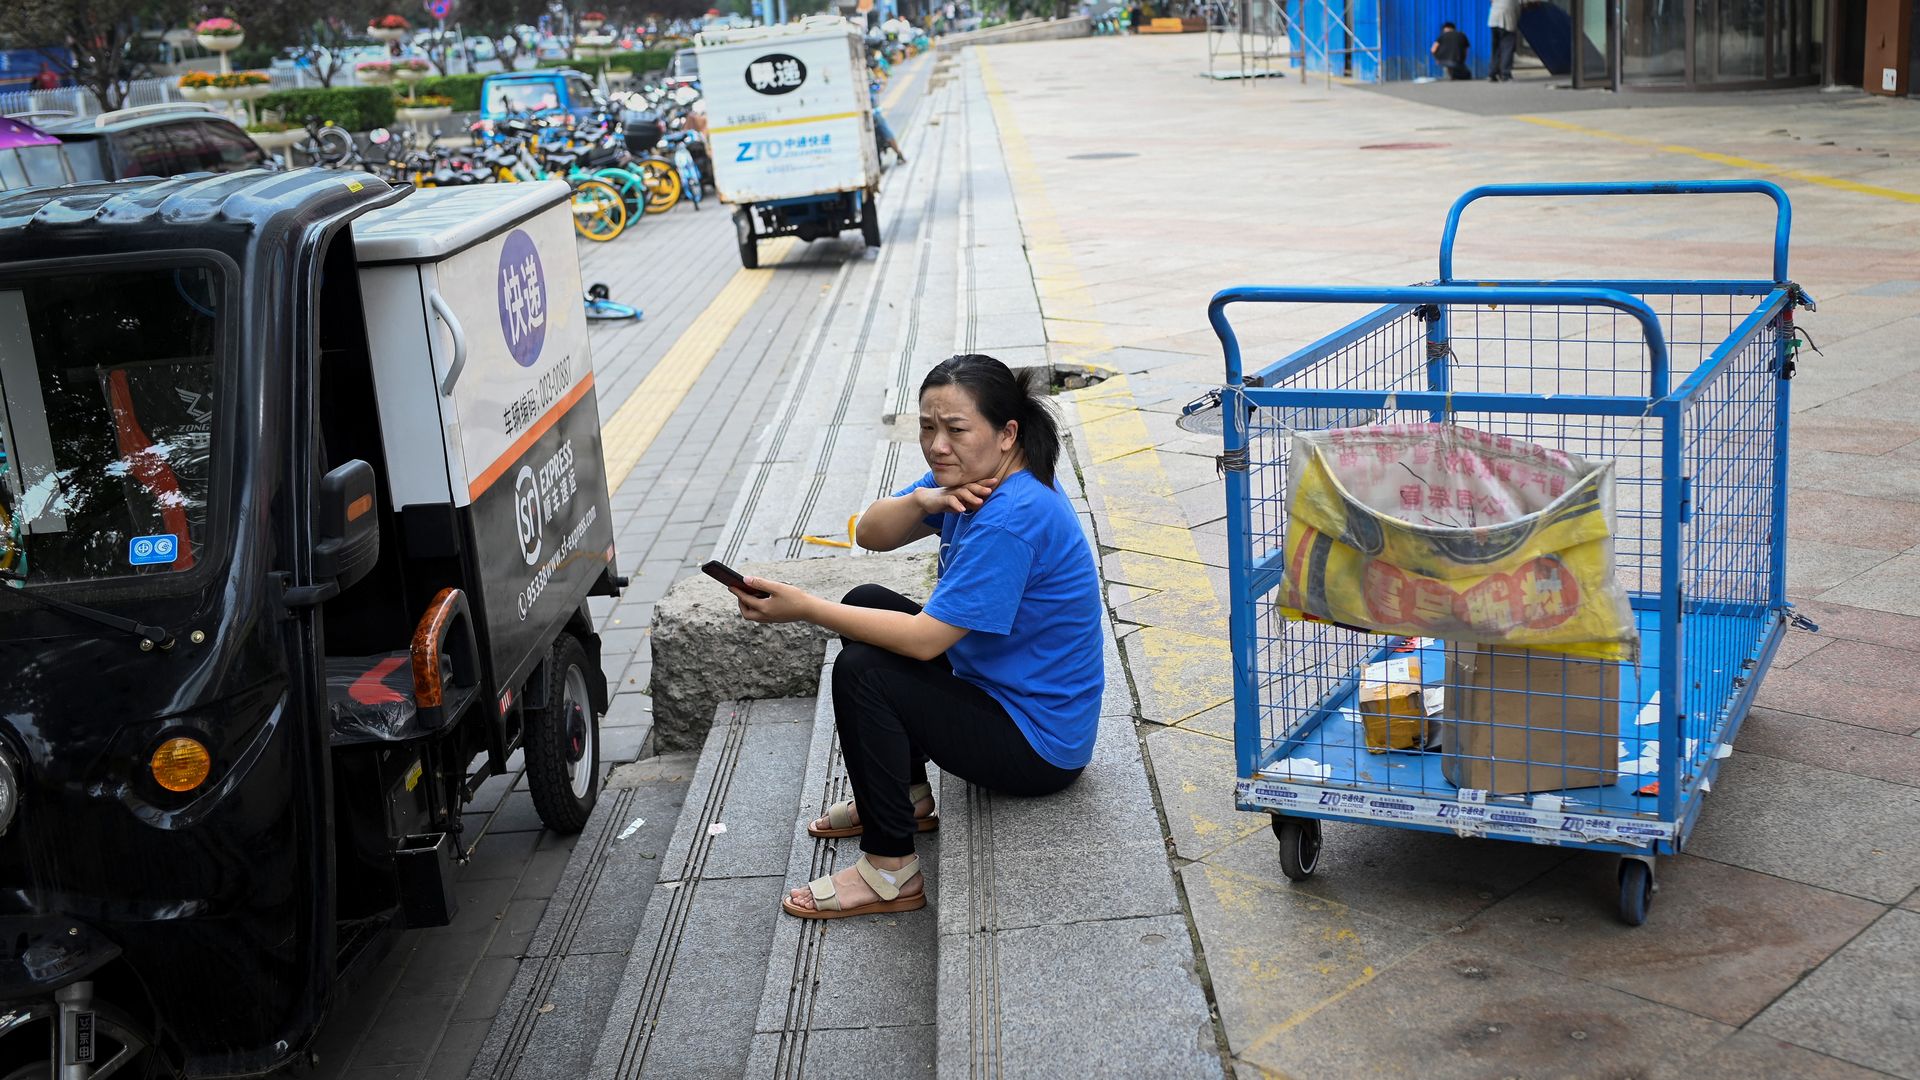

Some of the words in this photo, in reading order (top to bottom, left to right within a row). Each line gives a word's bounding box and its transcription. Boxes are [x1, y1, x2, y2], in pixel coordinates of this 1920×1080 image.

[736, 140, 782, 162] ZTO
[503, 254, 544, 346] 快递
[539, 439, 573, 496] EXPRESS
[543, 467, 577, 525] 顺丰速运
[1319, 791, 1340, 806] ZTO
[1342, 793, 1366, 803] 中通快递
[1437, 804, 1459, 818] ZTO
[1461, 806, 1485, 817] 中通快递
[1561, 817, 1584, 831] ZTO
